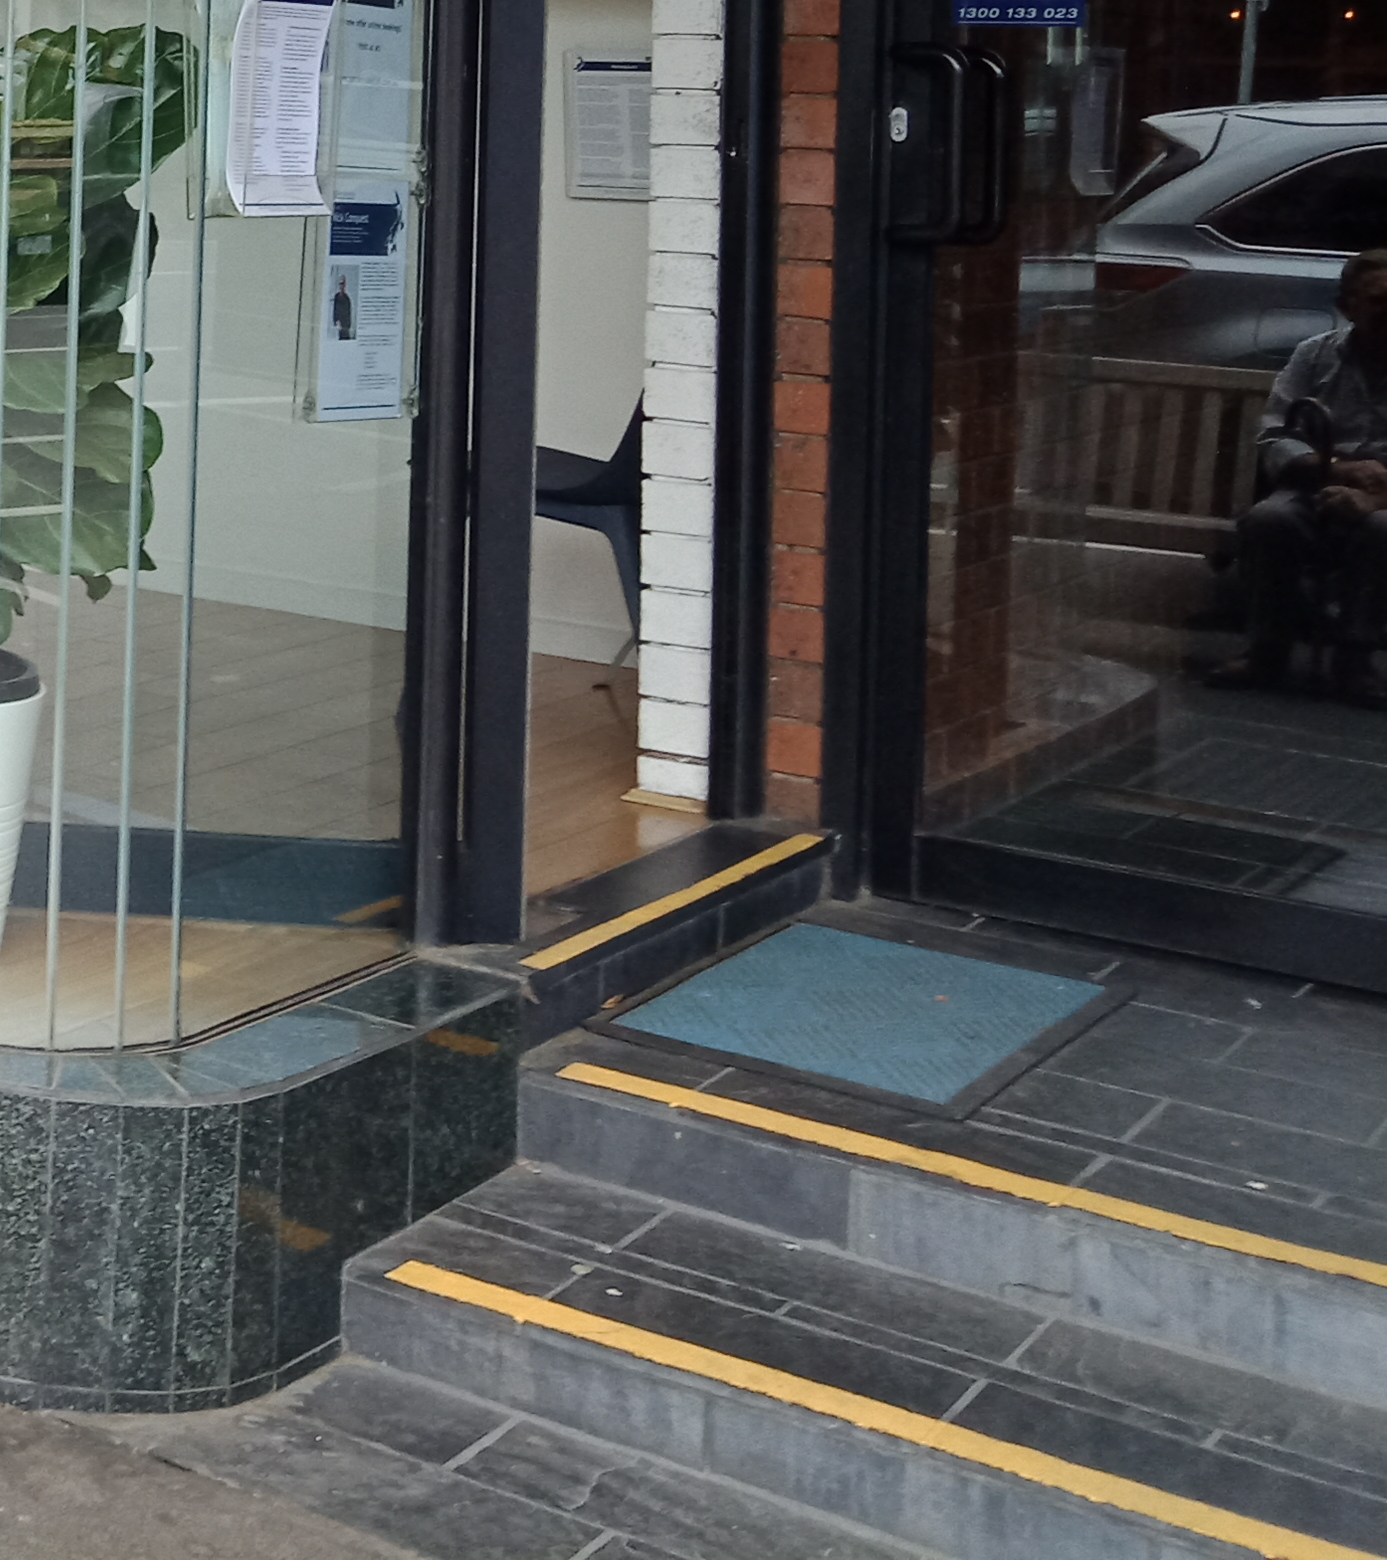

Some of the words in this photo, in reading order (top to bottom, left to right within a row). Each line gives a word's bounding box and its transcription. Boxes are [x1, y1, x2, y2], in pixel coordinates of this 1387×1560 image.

[958, 7, 1000, 19] 1300
[1006, 7, 1036, 19] 133
[1043, 7, 1079, 19] 023
